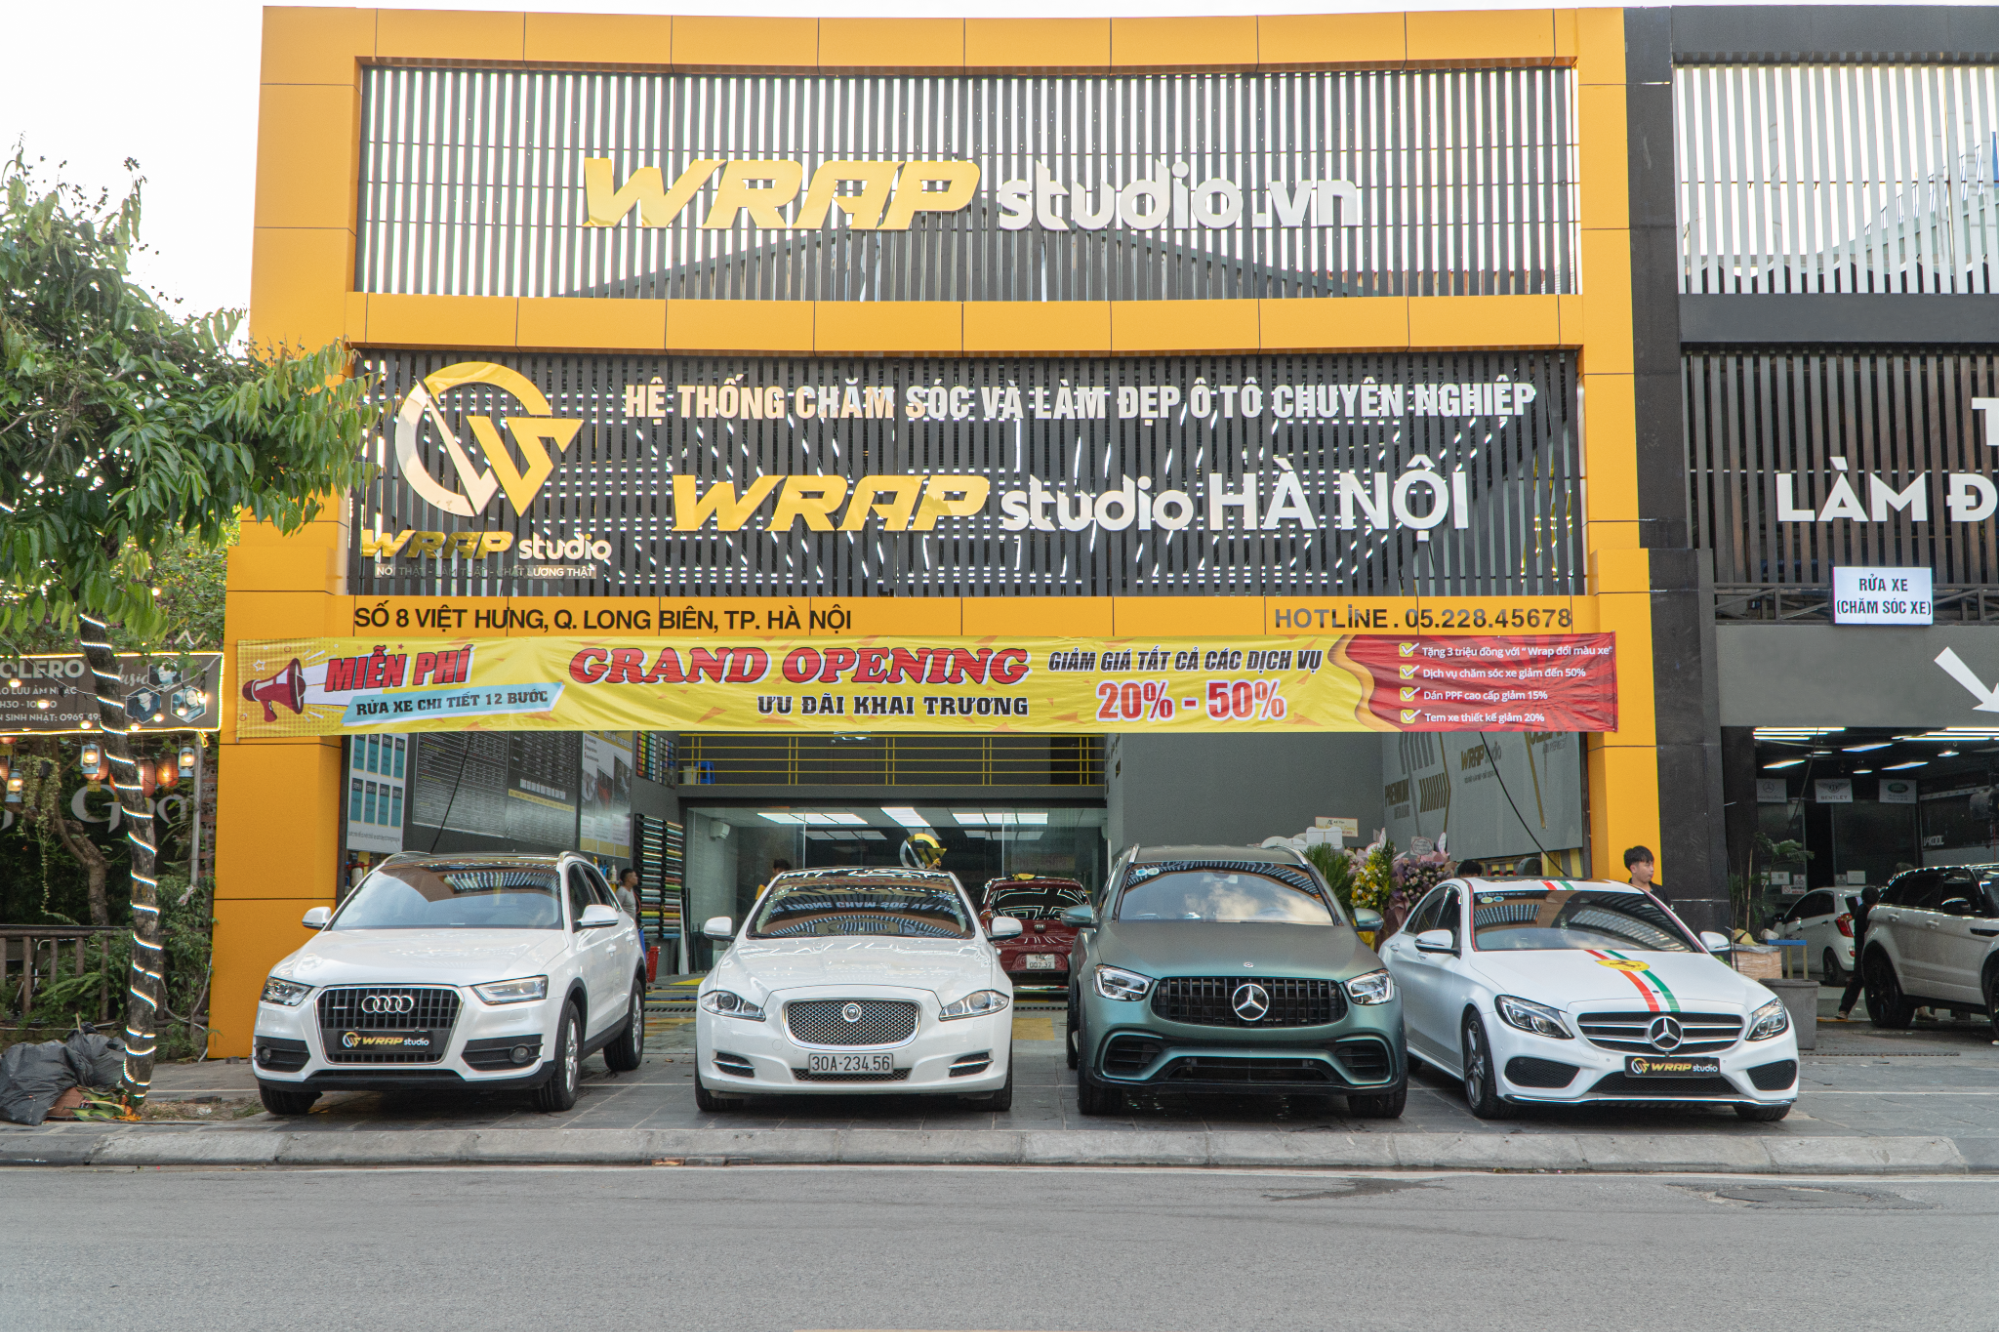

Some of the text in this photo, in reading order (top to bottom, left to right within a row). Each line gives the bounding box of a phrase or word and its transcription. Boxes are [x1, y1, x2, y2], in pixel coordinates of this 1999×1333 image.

[583, 157, 1359, 231] WRAP studio.vn
[625, 373, 1536, 426] HỆ THỐNG CHĂM SÓC VÀ LÀM ĐẸP Ô TÔ CHUYÊN NGHIỆP
[671, 454, 1469, 542] WRAP studio HÀ NỘI
[1777, 456, 1928, 522] LÀM
[361, 529, 612, 560] WRAP studio
[1858, 573, 1908, 592] RỬA XE
[354, 600, 390, 628] SỐ
[396, 608, 410, 628] 8
[414, 604, 468, 633] VIỆT
[554, 609, 577, 630] Q.
[583, 609, 651, 630] LONG
[660, 605, 718, 633] BIÊN,
[724, 610, 760, 630] TP.
[768, 605, 801, 630] HÀ
[810, 604, 852, 634] NỘI
[1405, 608, 1572, 629] 05.228.45678
[1836, 597, 1931, 616] (CHĂM SÓC XE)
[1049, 645, 1323, 674] GIẢM GIÁ TẤT CẢ CÁC DỊCH VỤ
[1447, 648, 1453, 656] 3
[1528, 647, 1554, 658] Wrap
[1573, 646, 1596, 656] màu
[324, 644, 473, 693] MIỄN PHÍ
[568, 646, 1030, 685] GRAND OPENING
[1423, 668, 1444, 680] Dịch
[1445, 670, 1457, 680] vụ
[1459, 667, 1486, 678] chăm
[1488, 668, 1503, 678] sóc
[1506, 670, 1517, 678] xe
[1565, 668, 1586, 678] 50%
[356, 689, 548, 716] RỬA XE CHI TIẾT 12 BƯỚC
[757, 691, 1029, 716] ƯU ĐÃI KHAI TRƯƠNG
[1096, 680, 1287, 721] 20% - 50%
[1424, 690, 1444, 700] Dán
[1445, 691, 1463, 700] PPF
[1465, 692, 1481, 700] cao
[1483, 690, 1500, 702] cấp
[1528, 691, 1548, 700] 15%
[5, 713, 28, 722] SINH
[1425, 713, 1446, 722] Tem
[1448, 714, 1459, 722] xe
[1524, 713, 1544, 722] 20%
[362, 1036, 430, 1047] WRAP studio
[811, 1055, 890, 1071] 30A-234.56
[1651, 1062, 1718, 1073] WRAP studio
